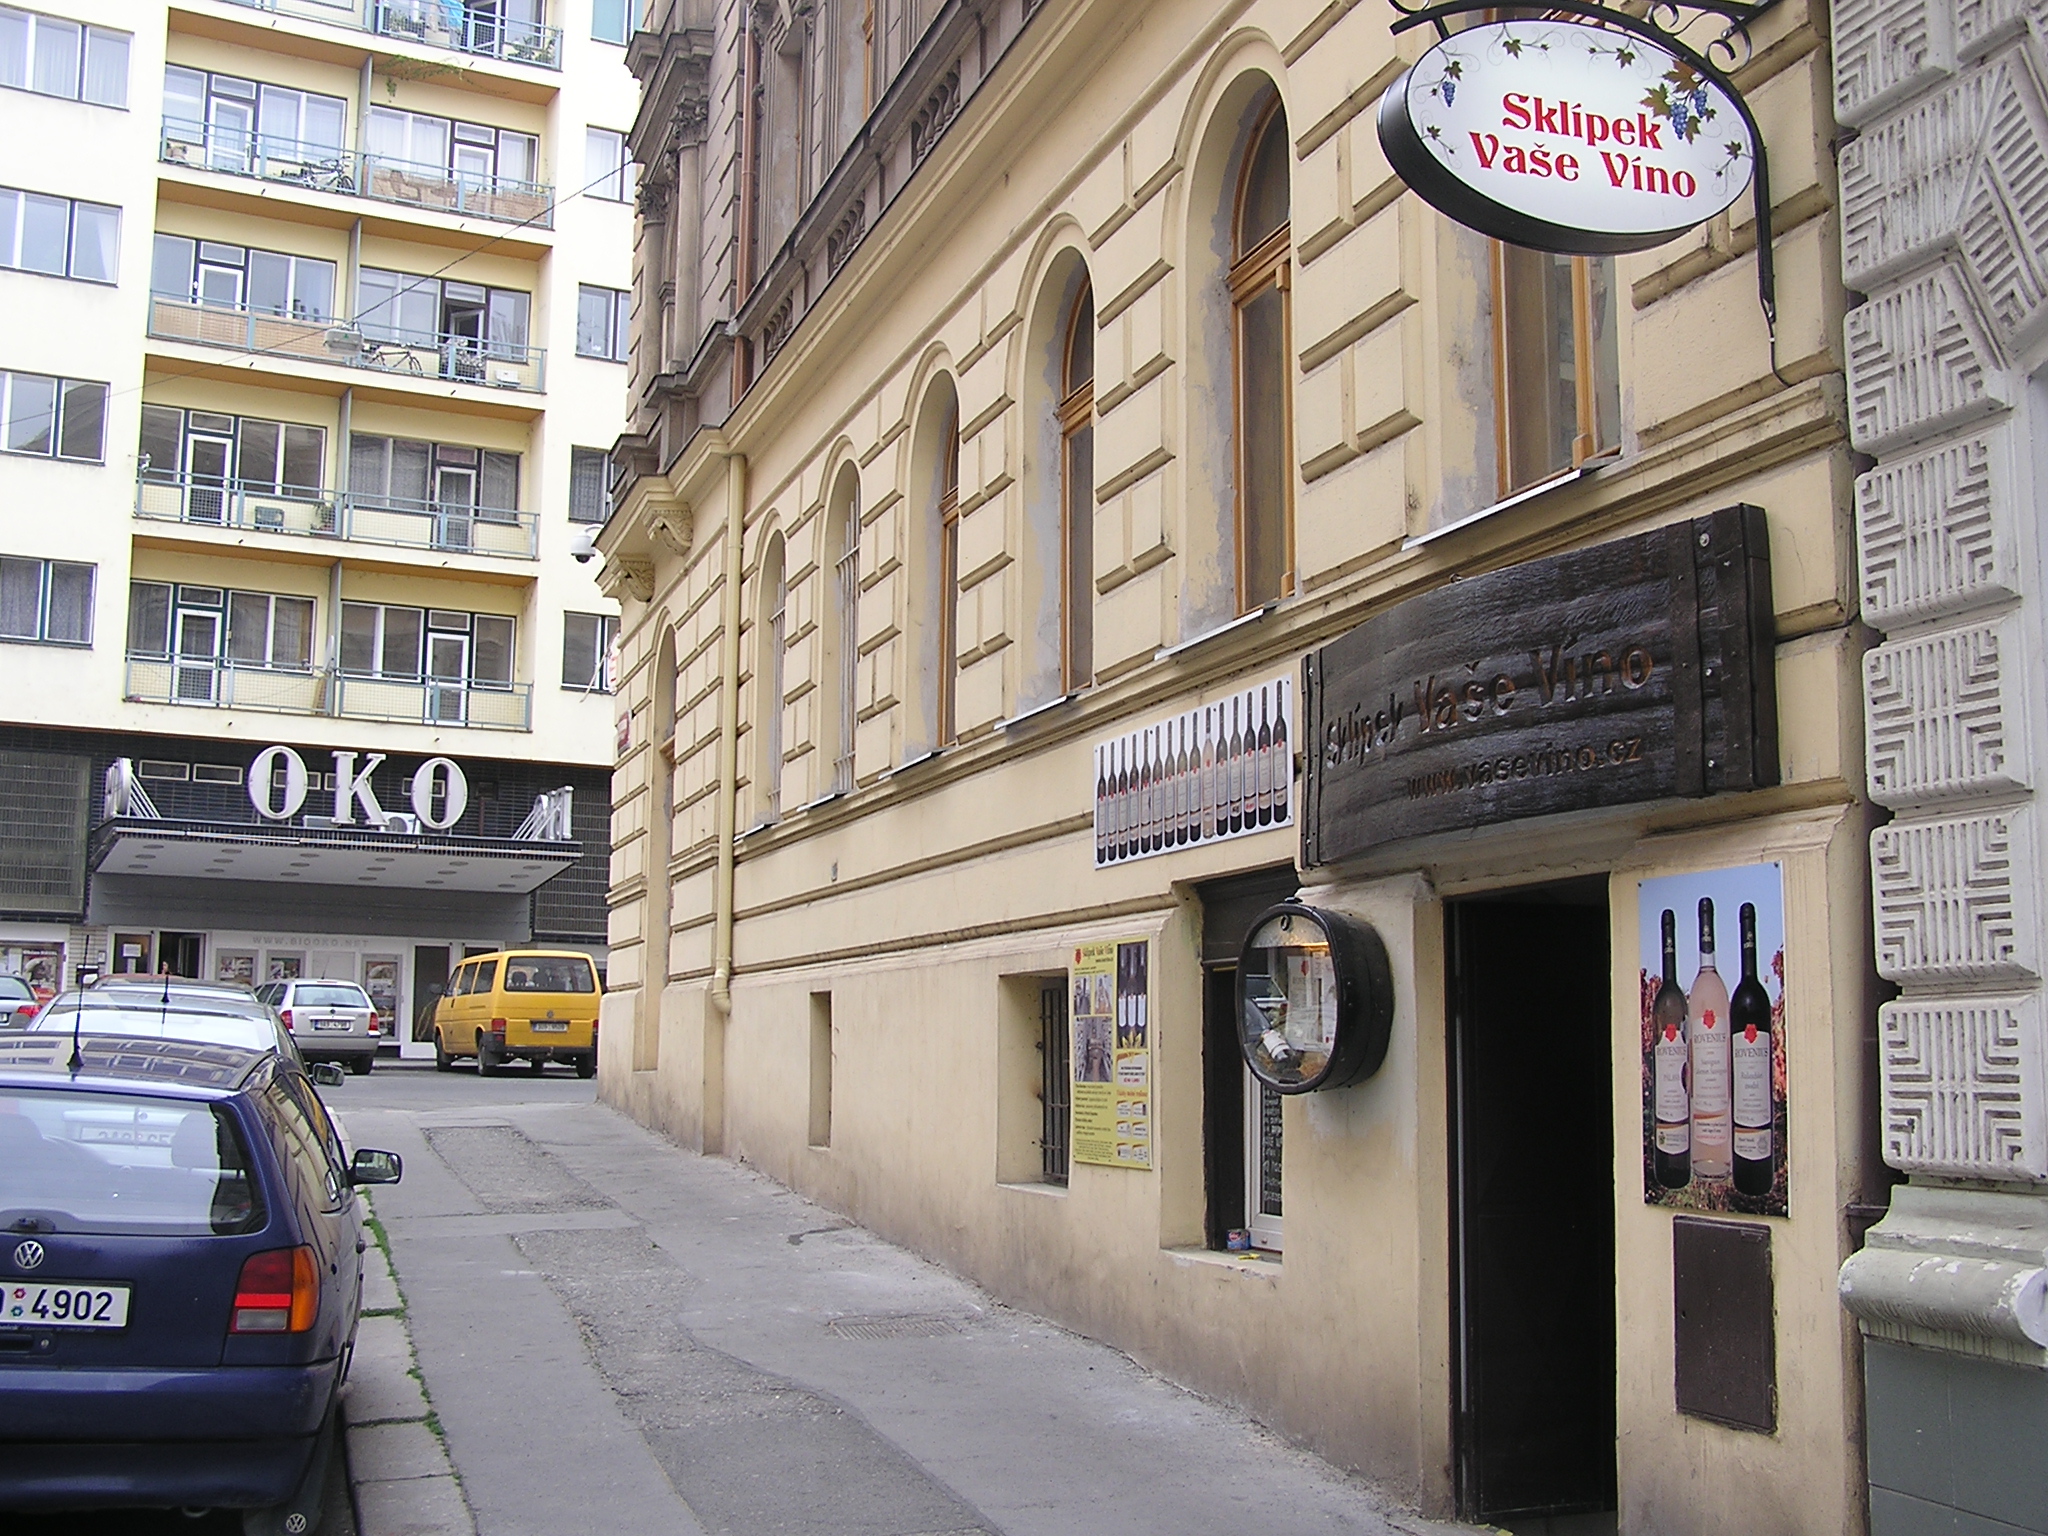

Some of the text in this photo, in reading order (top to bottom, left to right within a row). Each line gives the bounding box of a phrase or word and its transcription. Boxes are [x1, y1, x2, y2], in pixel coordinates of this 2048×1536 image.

[1502, 92, 1663, 150] Sklípek
[1468, 131, 1697, 198] Vaše Víno
[1326, 637, 1654, 769] Sklípek Vaše Víno
[248, 745, 468, 830] OKO
[1407, 737, 1643, 801] www.vasevino.cz
